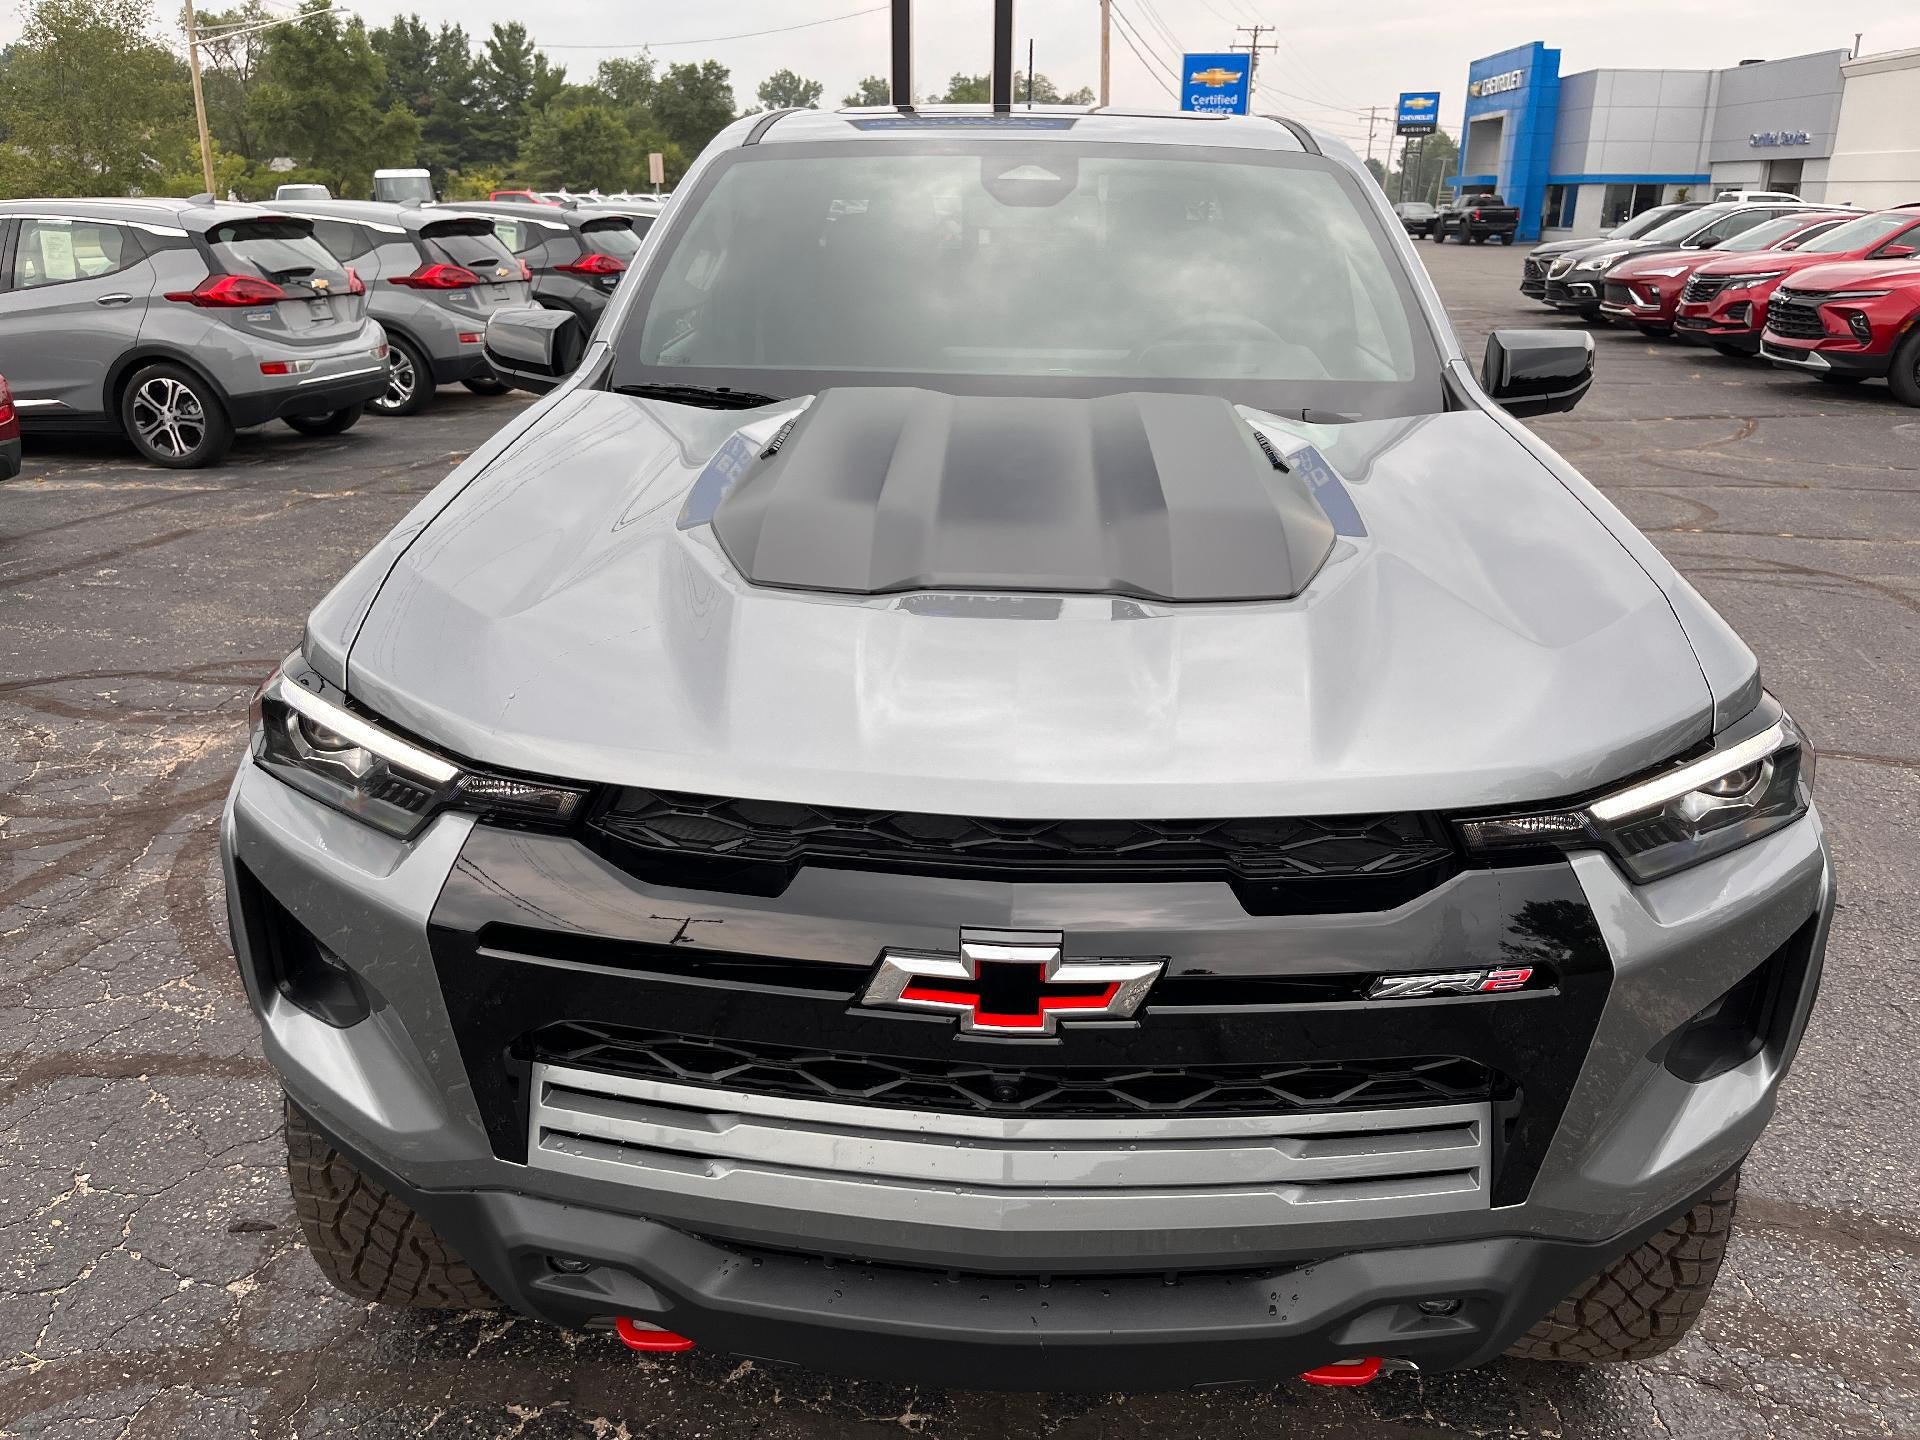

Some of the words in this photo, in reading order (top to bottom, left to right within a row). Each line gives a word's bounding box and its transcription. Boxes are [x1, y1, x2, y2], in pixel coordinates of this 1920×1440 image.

[1481, 69, 1525, 97] CHEVROLET
[1190, 94, 1238, 105] Certified
[1399, 113, 1434, 121] CHEVROLET
[1369, 968, 1534, 999] ZR2
